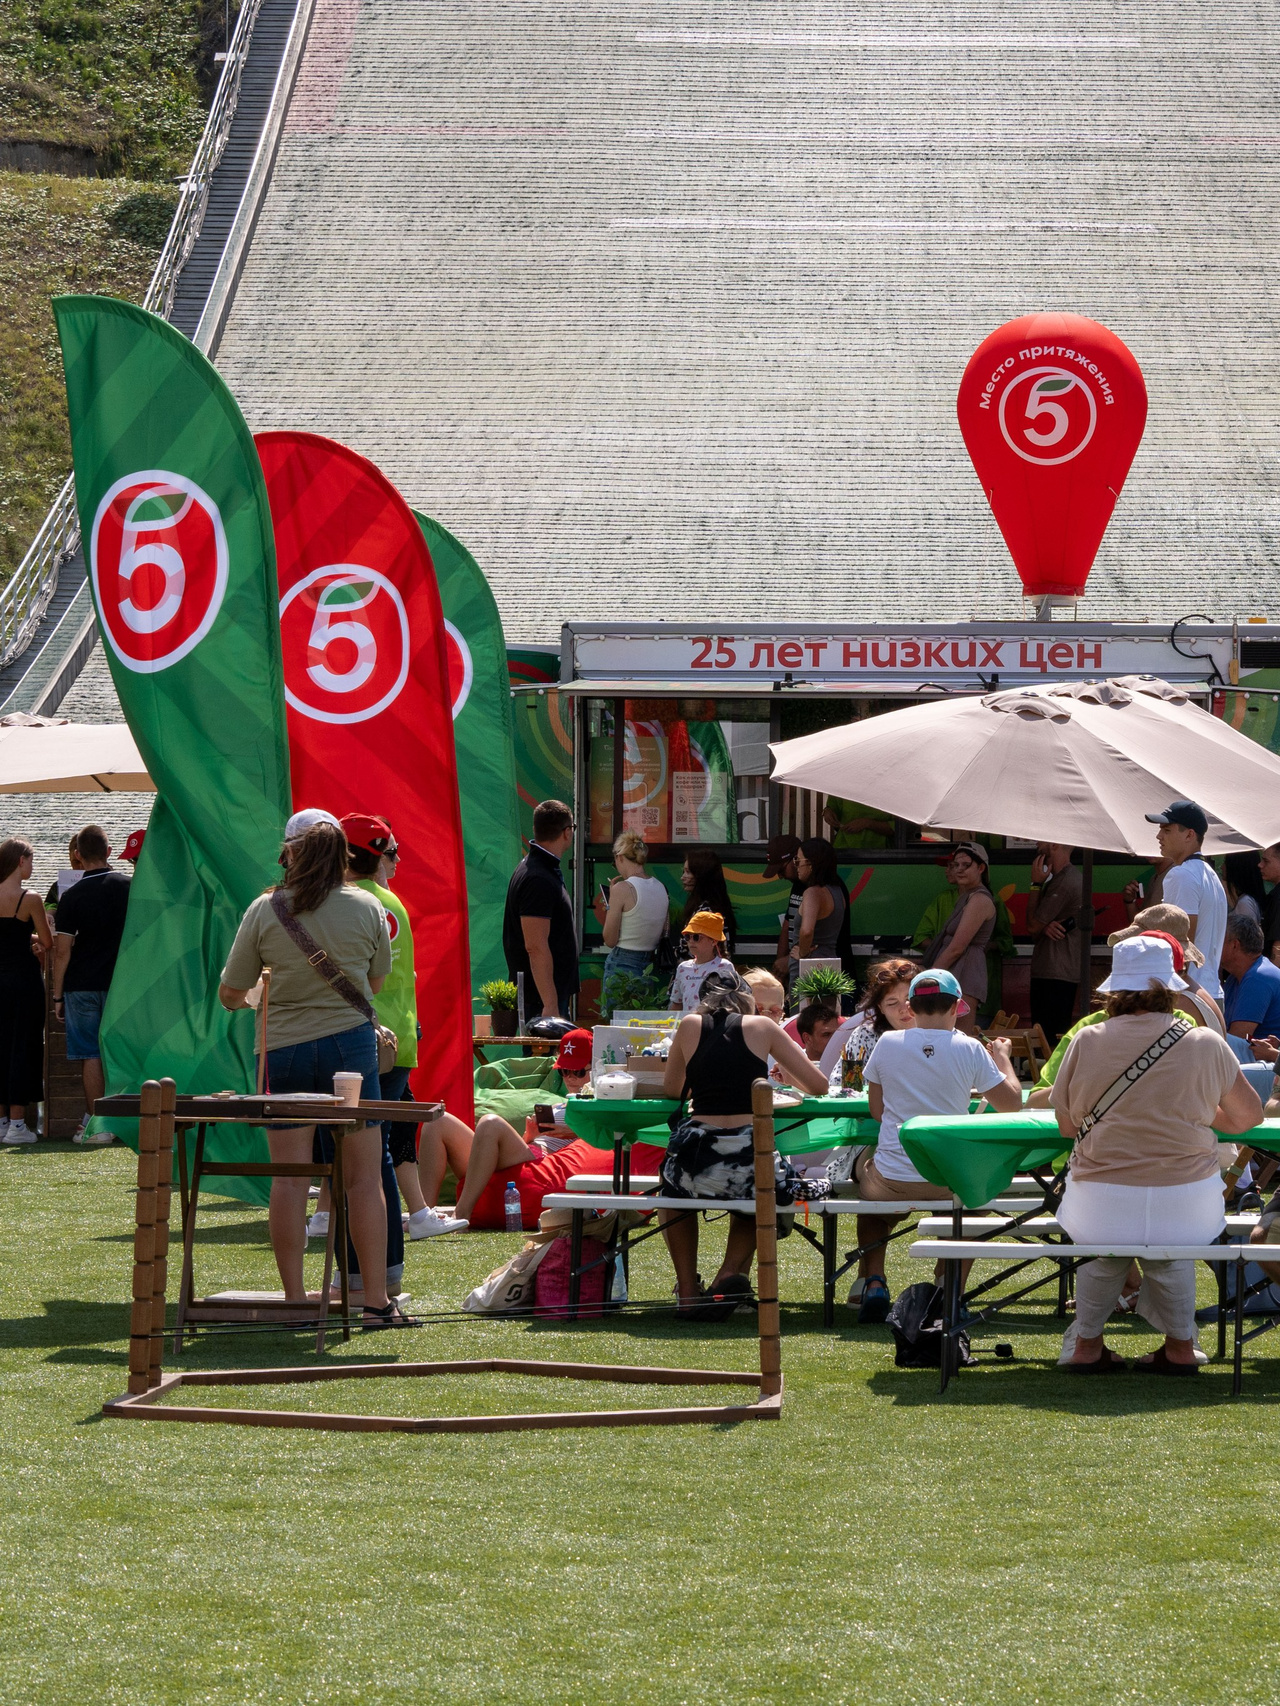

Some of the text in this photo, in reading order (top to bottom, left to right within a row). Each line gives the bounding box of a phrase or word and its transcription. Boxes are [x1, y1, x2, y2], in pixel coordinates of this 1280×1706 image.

[979, 345, 1115, 410] Место притяжения
[1023, 375, 1076, 447] 5
[118, 486, 194, 634] 5
[306, 574, 378, 694] 5
[690, 636, 1102, 673] 25 лет низких цен
